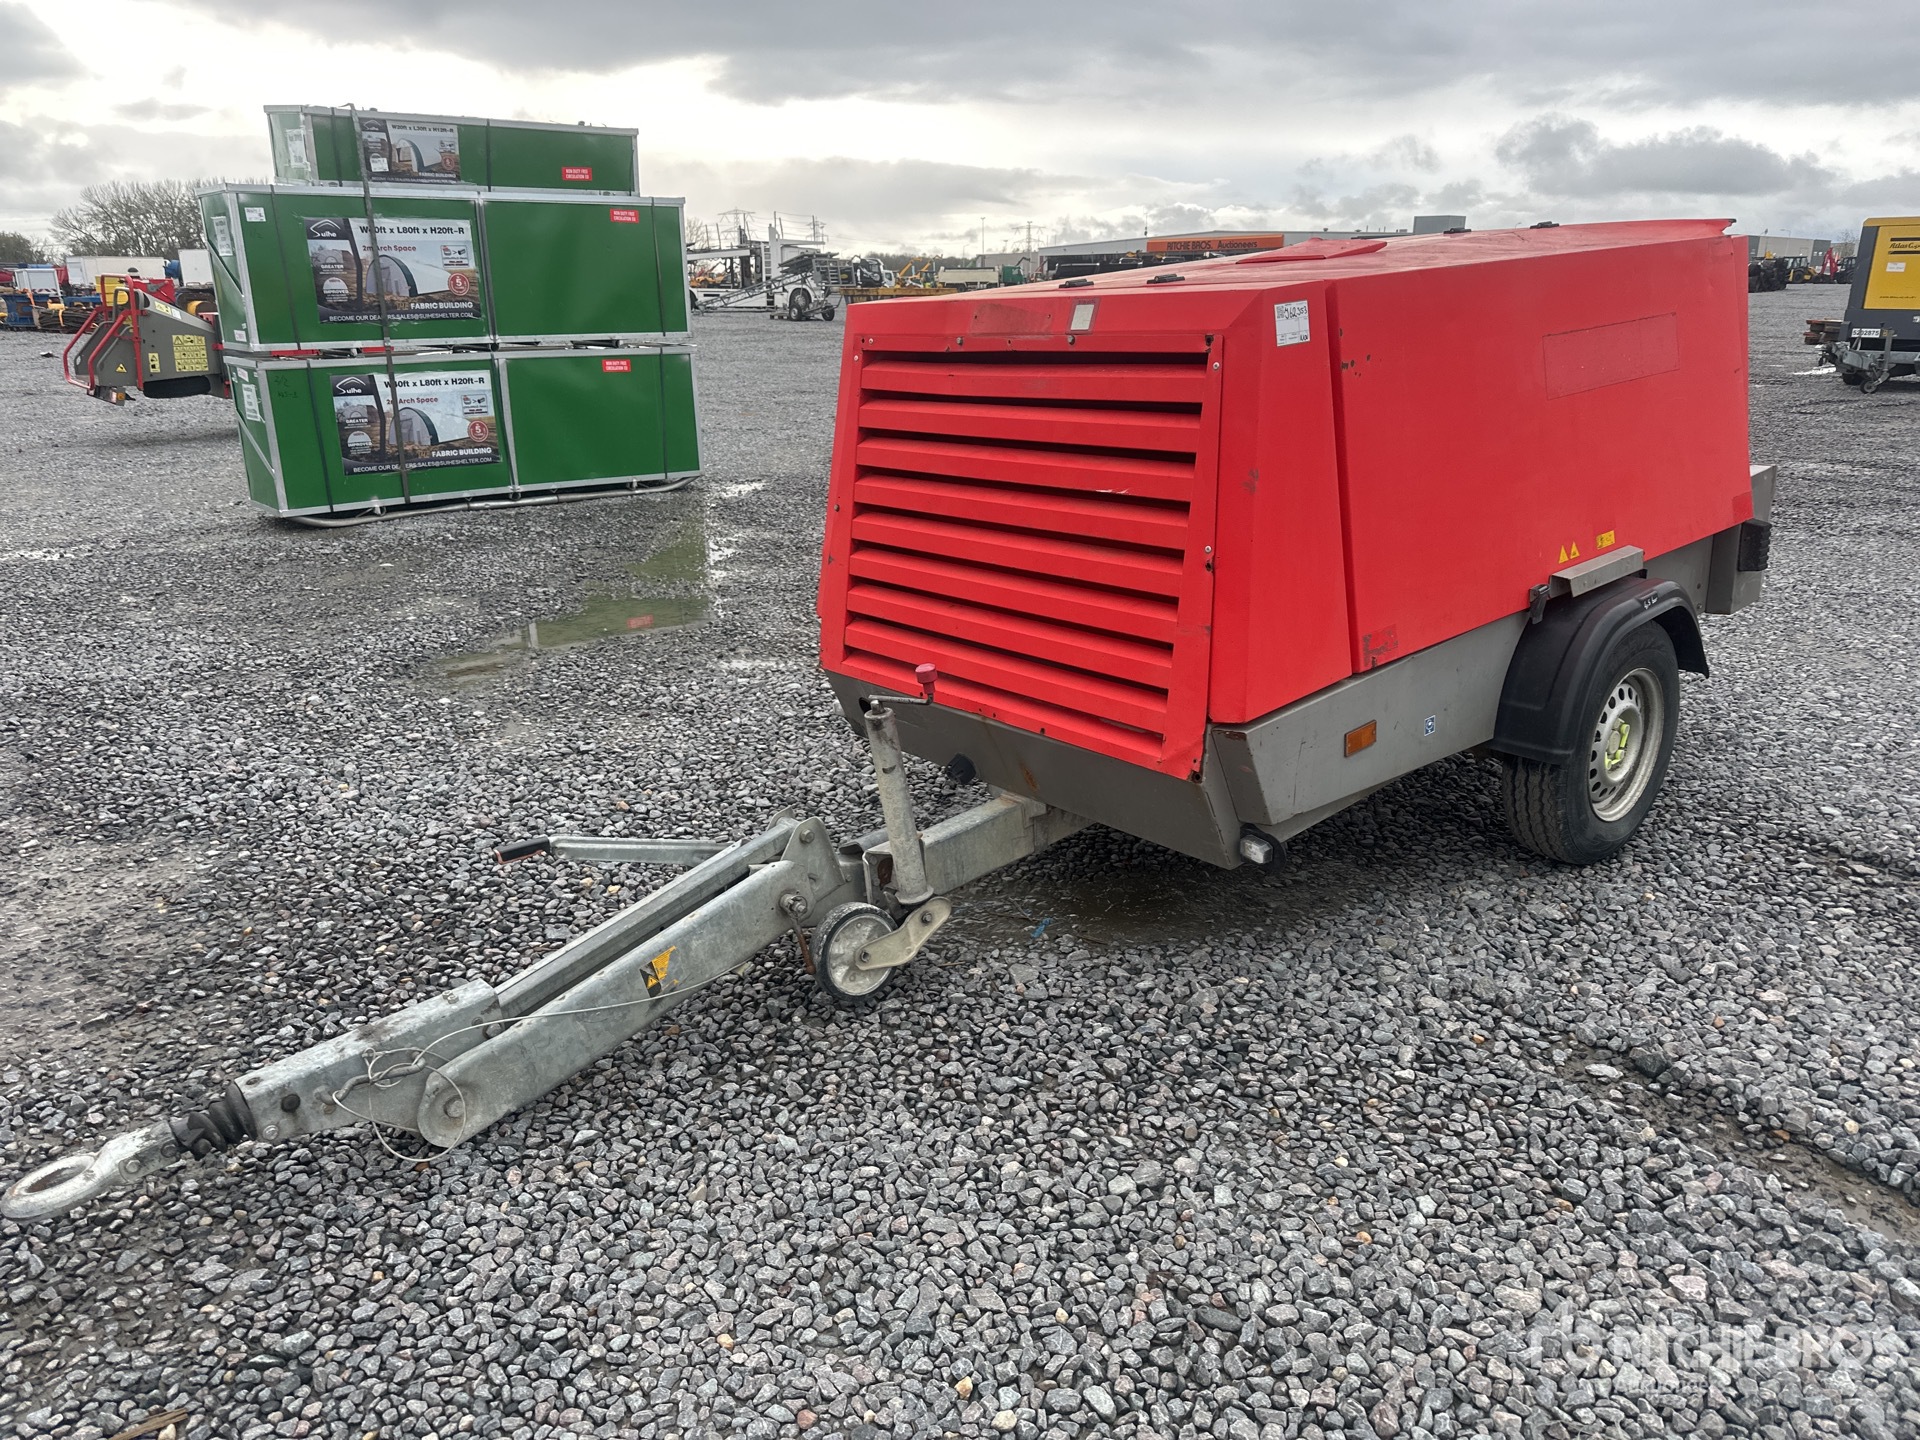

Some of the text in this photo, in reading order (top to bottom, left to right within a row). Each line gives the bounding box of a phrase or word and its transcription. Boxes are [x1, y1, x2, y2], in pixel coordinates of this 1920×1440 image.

[1167, 241, 1190, 250] RITCHIE
[1217, 241, 1257, 249] Auctioneers
[456, 278, 462, 286] 5
[459, 447, 492, 456] BUILDING
